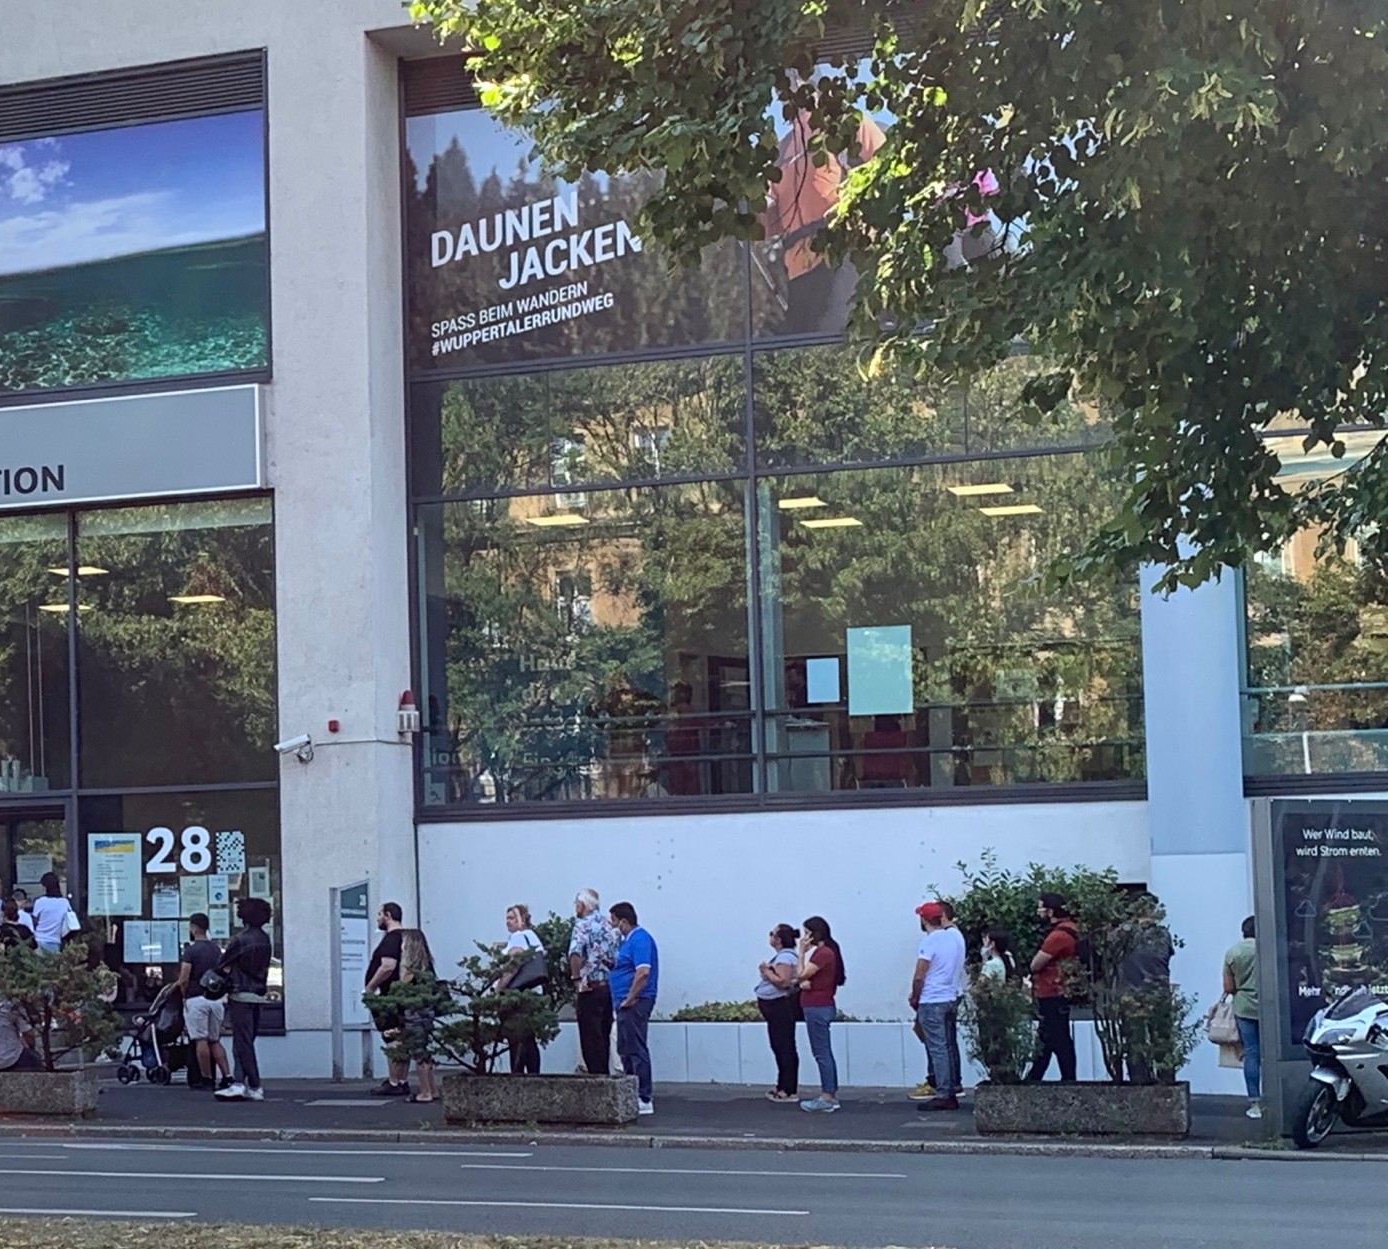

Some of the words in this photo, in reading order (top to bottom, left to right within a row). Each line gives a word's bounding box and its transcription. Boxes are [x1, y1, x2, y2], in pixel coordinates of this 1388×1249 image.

[431, 191, 579, 268] DAUNEN
[498, 220, 643, 290] JACKEN
[431, 312, 476, 338] SPASS
[479, 302, 513, 325] BEIM
[517, 281, 588, 314] WANDERN
[431, 293, 614, 357] #WUPPERTALERRUNDWEG
[146, 826, 211, 873] 28
[1295, 845, 1318, 856] wird
[1320, 845, 1348, 857] Strom
[1302, 828, 1322, 840] Wer
[1324, 828, 1350, 840] Wind
[1298, 985, 1322, 997] Mehr
